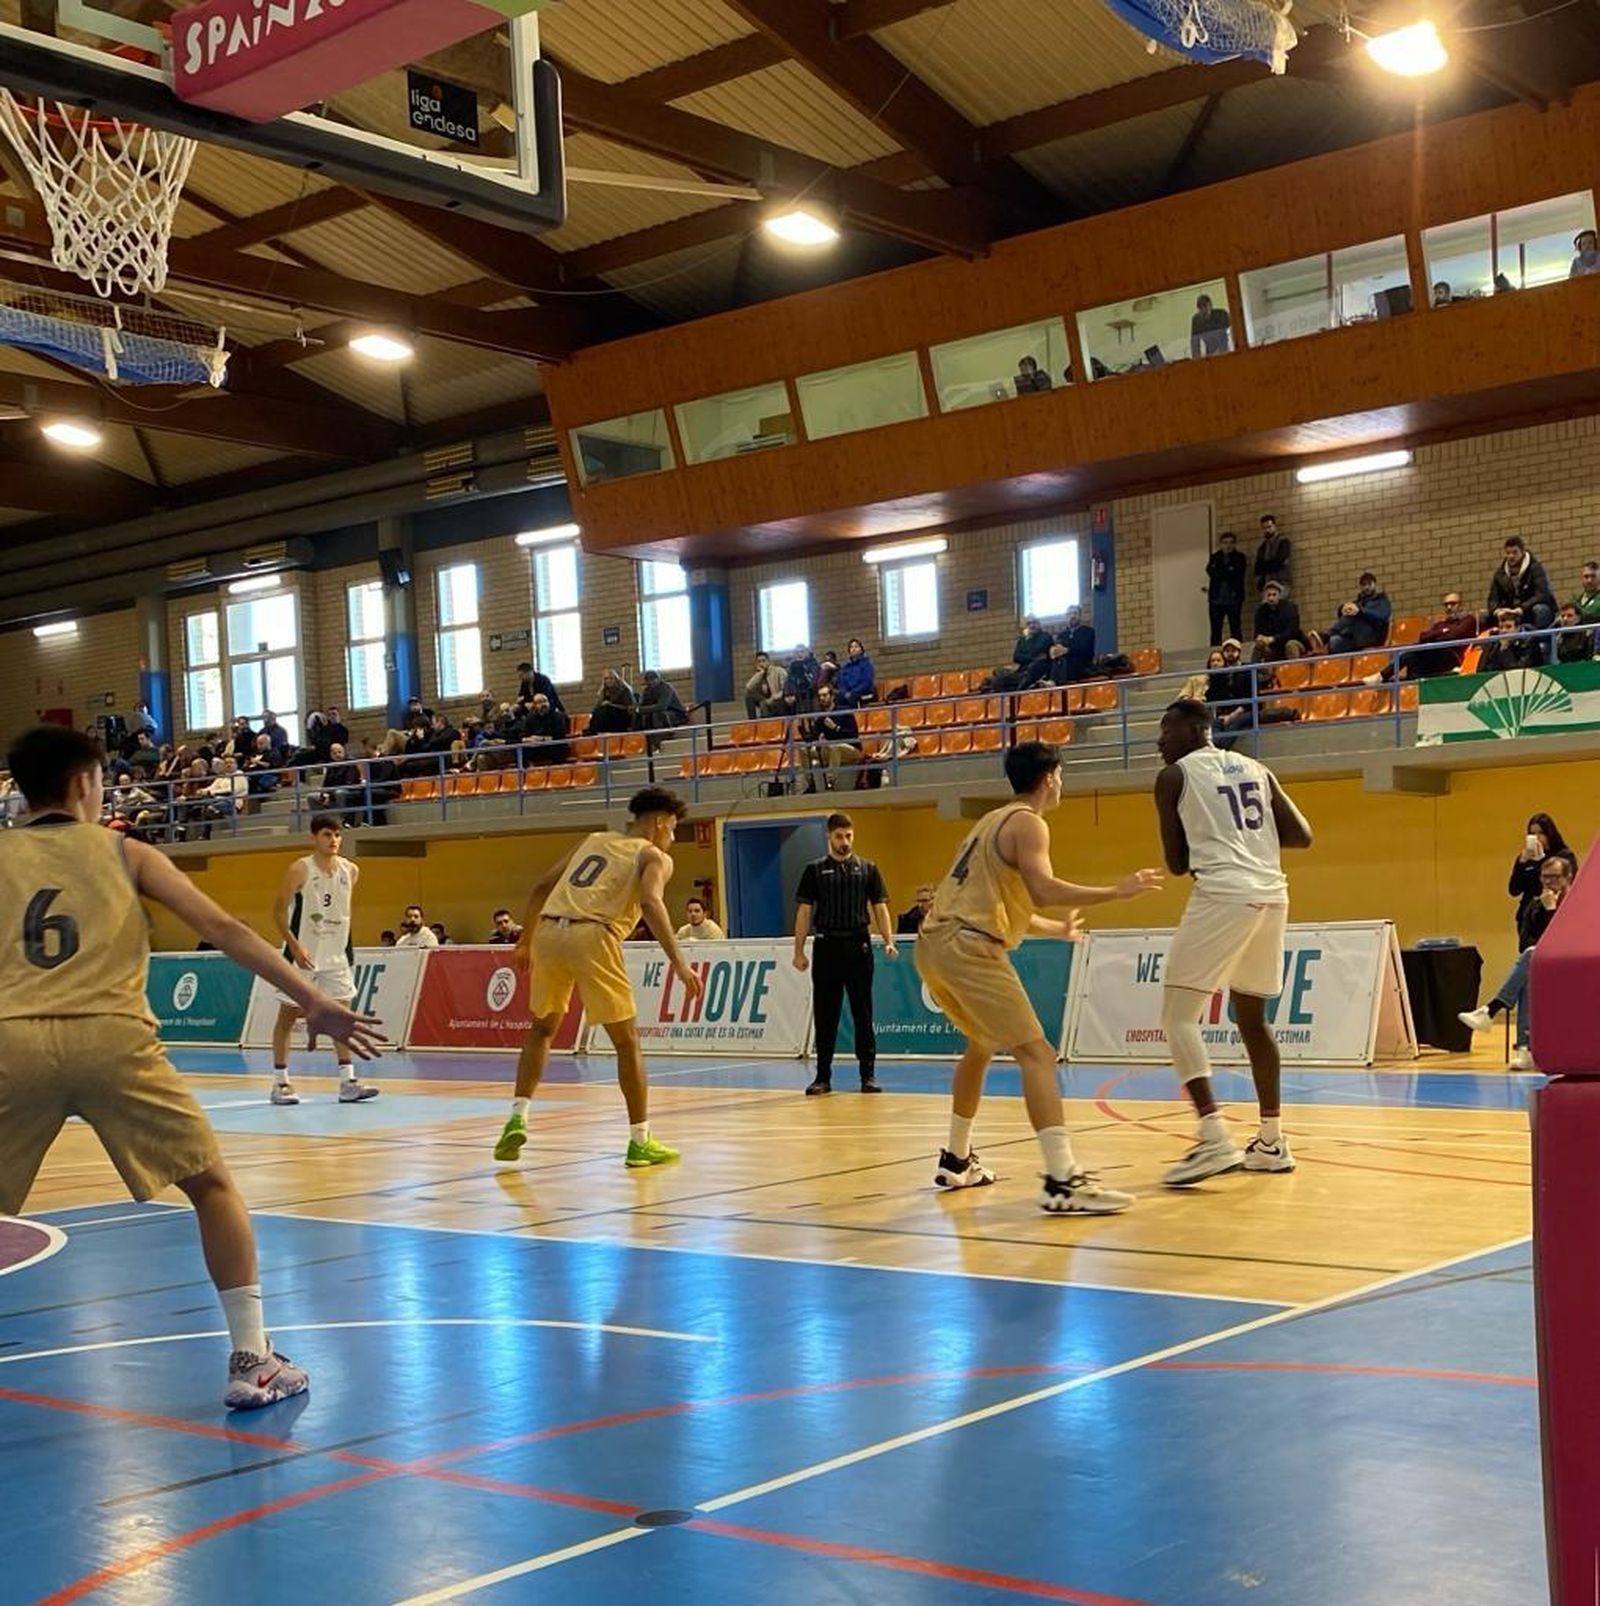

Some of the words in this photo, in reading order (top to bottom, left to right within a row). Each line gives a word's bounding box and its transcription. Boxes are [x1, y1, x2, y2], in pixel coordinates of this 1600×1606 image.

[411, 89, 441, 112] liga
[412, 111, 476, 141] endesa
[1217, 782, 1263, 830] 15
[569, 854, 608, 888] 0
[951, 837, 978, 886] 4
[323, 893, 332, 907] 3
[23, 888, 79, 970] 6
[643, 962, 664, 987] WE
[1136, 953, 1164, 983] WE
[449, 1018, 488, 1030] Ajuntament
[929, 1022, 942, 1034] de
